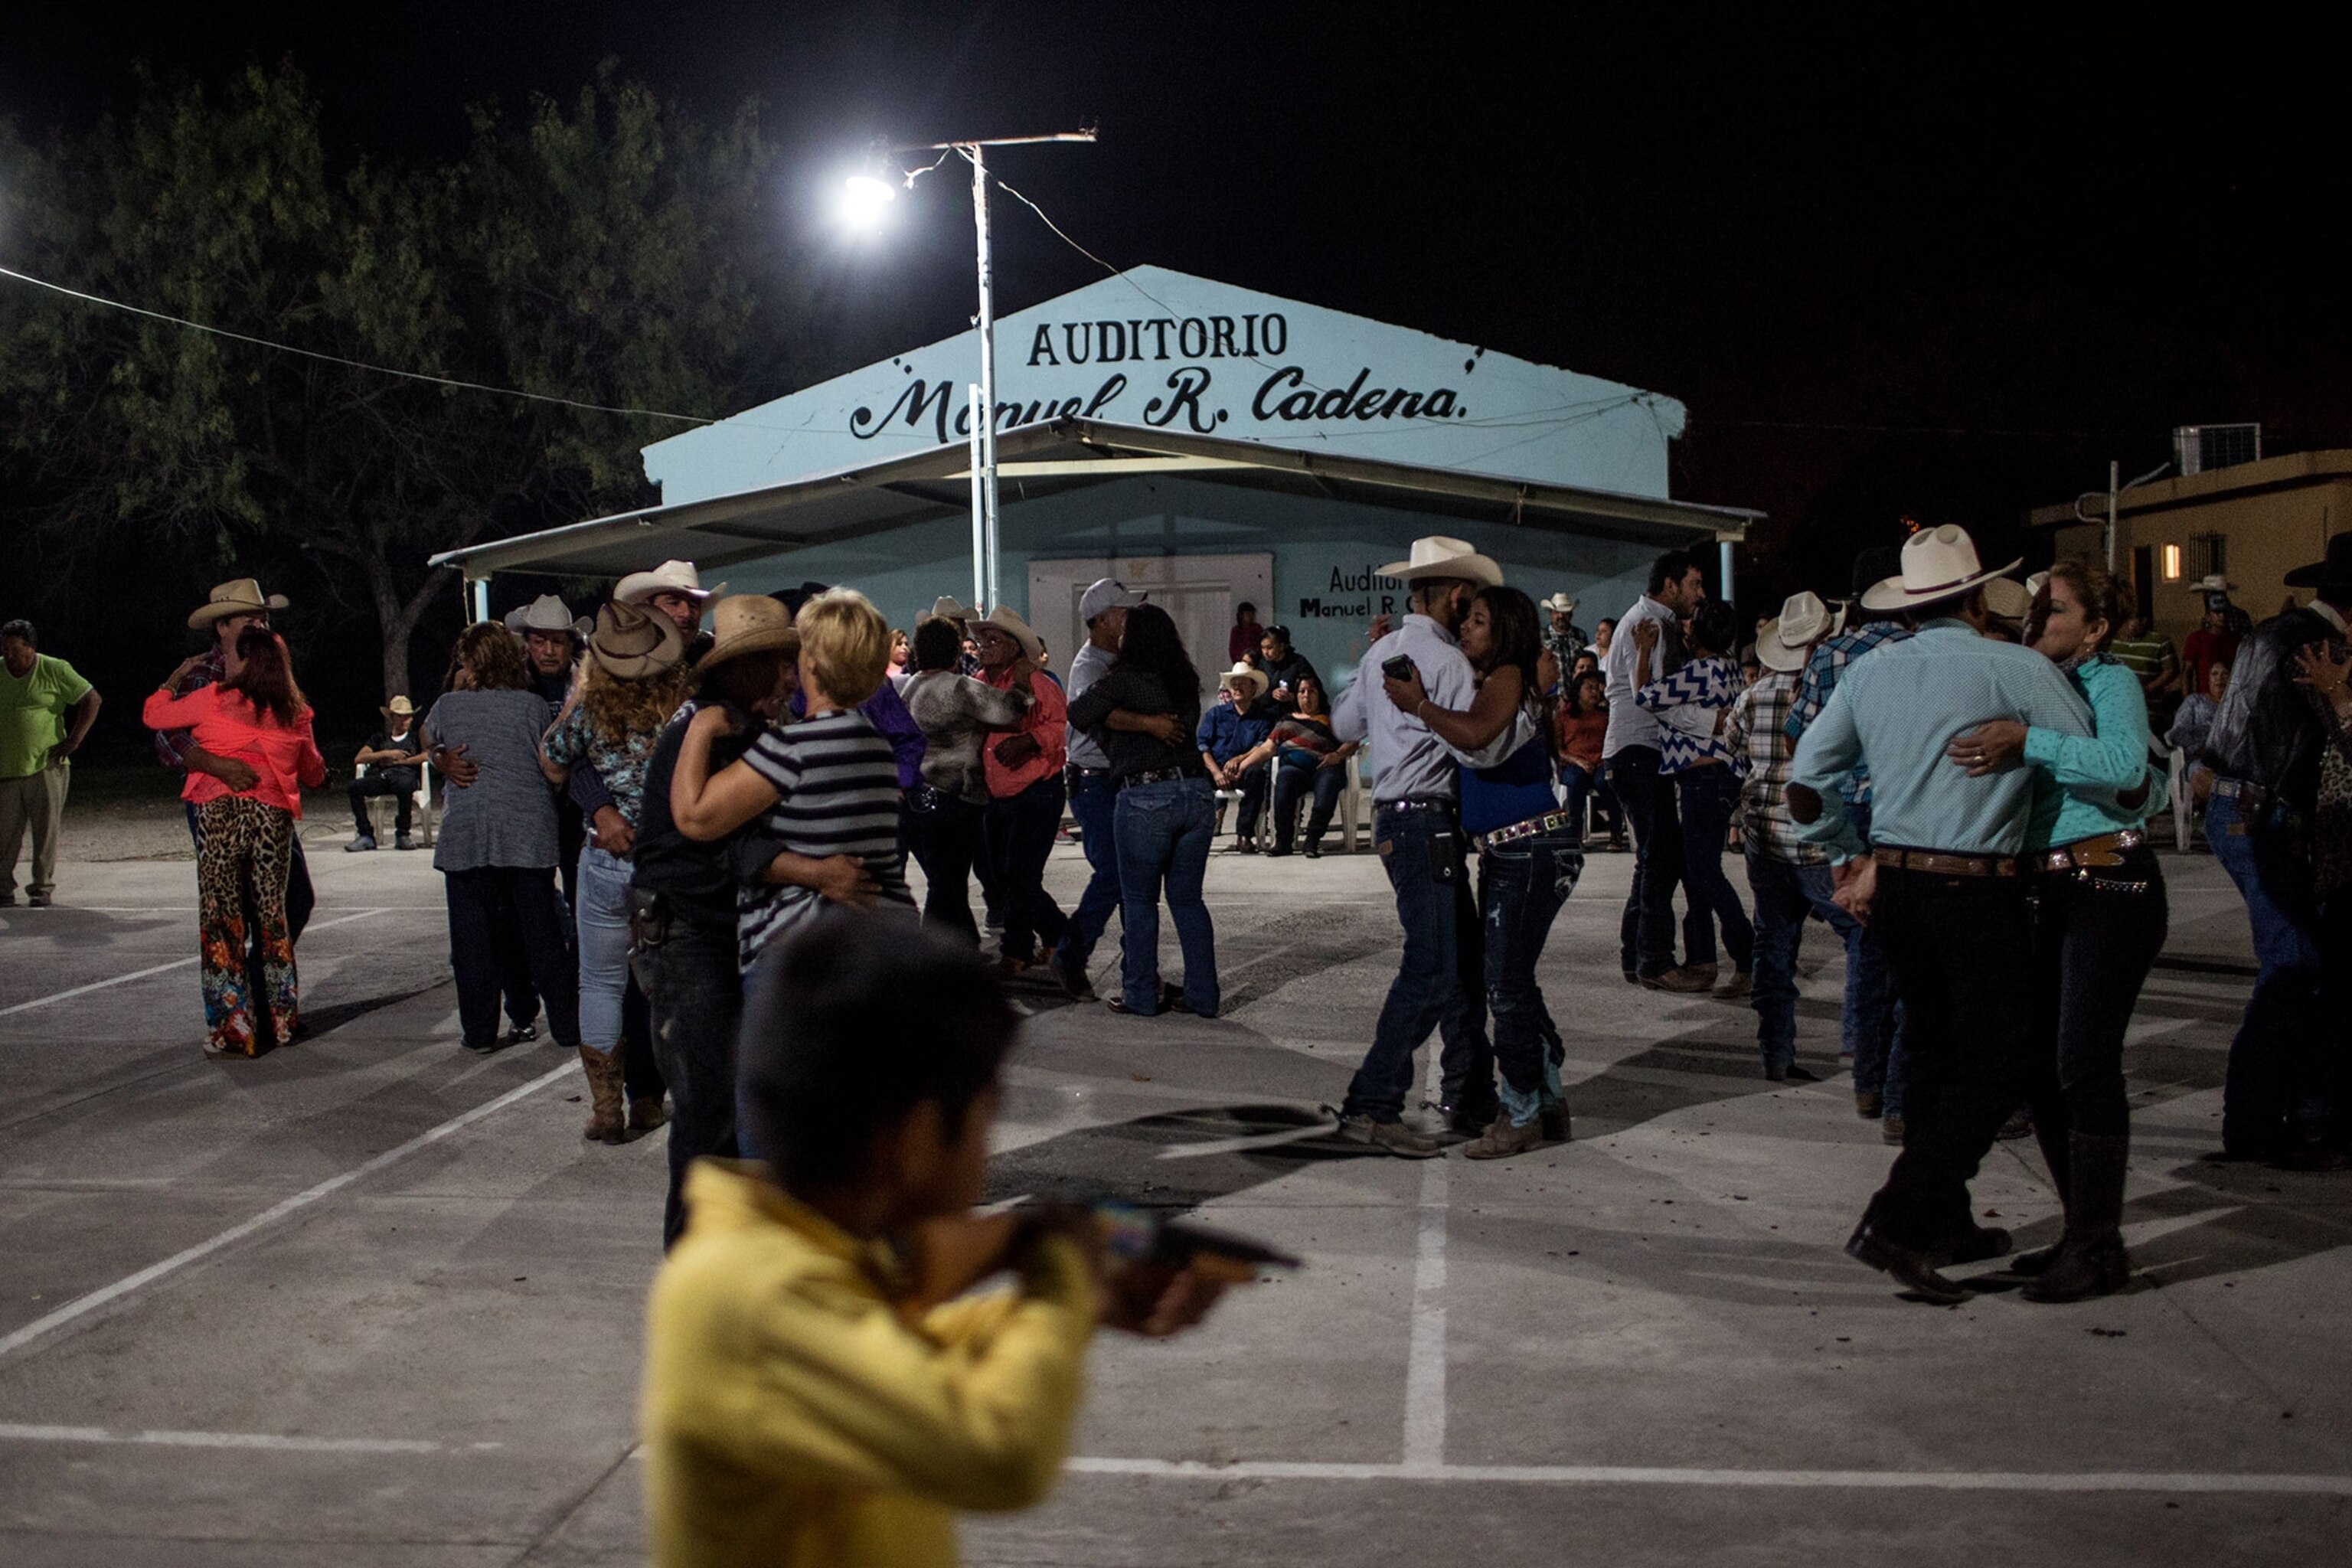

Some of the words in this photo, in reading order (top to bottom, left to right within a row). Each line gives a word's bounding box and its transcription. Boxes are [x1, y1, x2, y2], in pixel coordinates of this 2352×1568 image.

[1027, 313, 1287, 366] AUDITORIO
[1143, 366, 1228, 433] R.
[1300, 596, 1370, 617] Manuel
